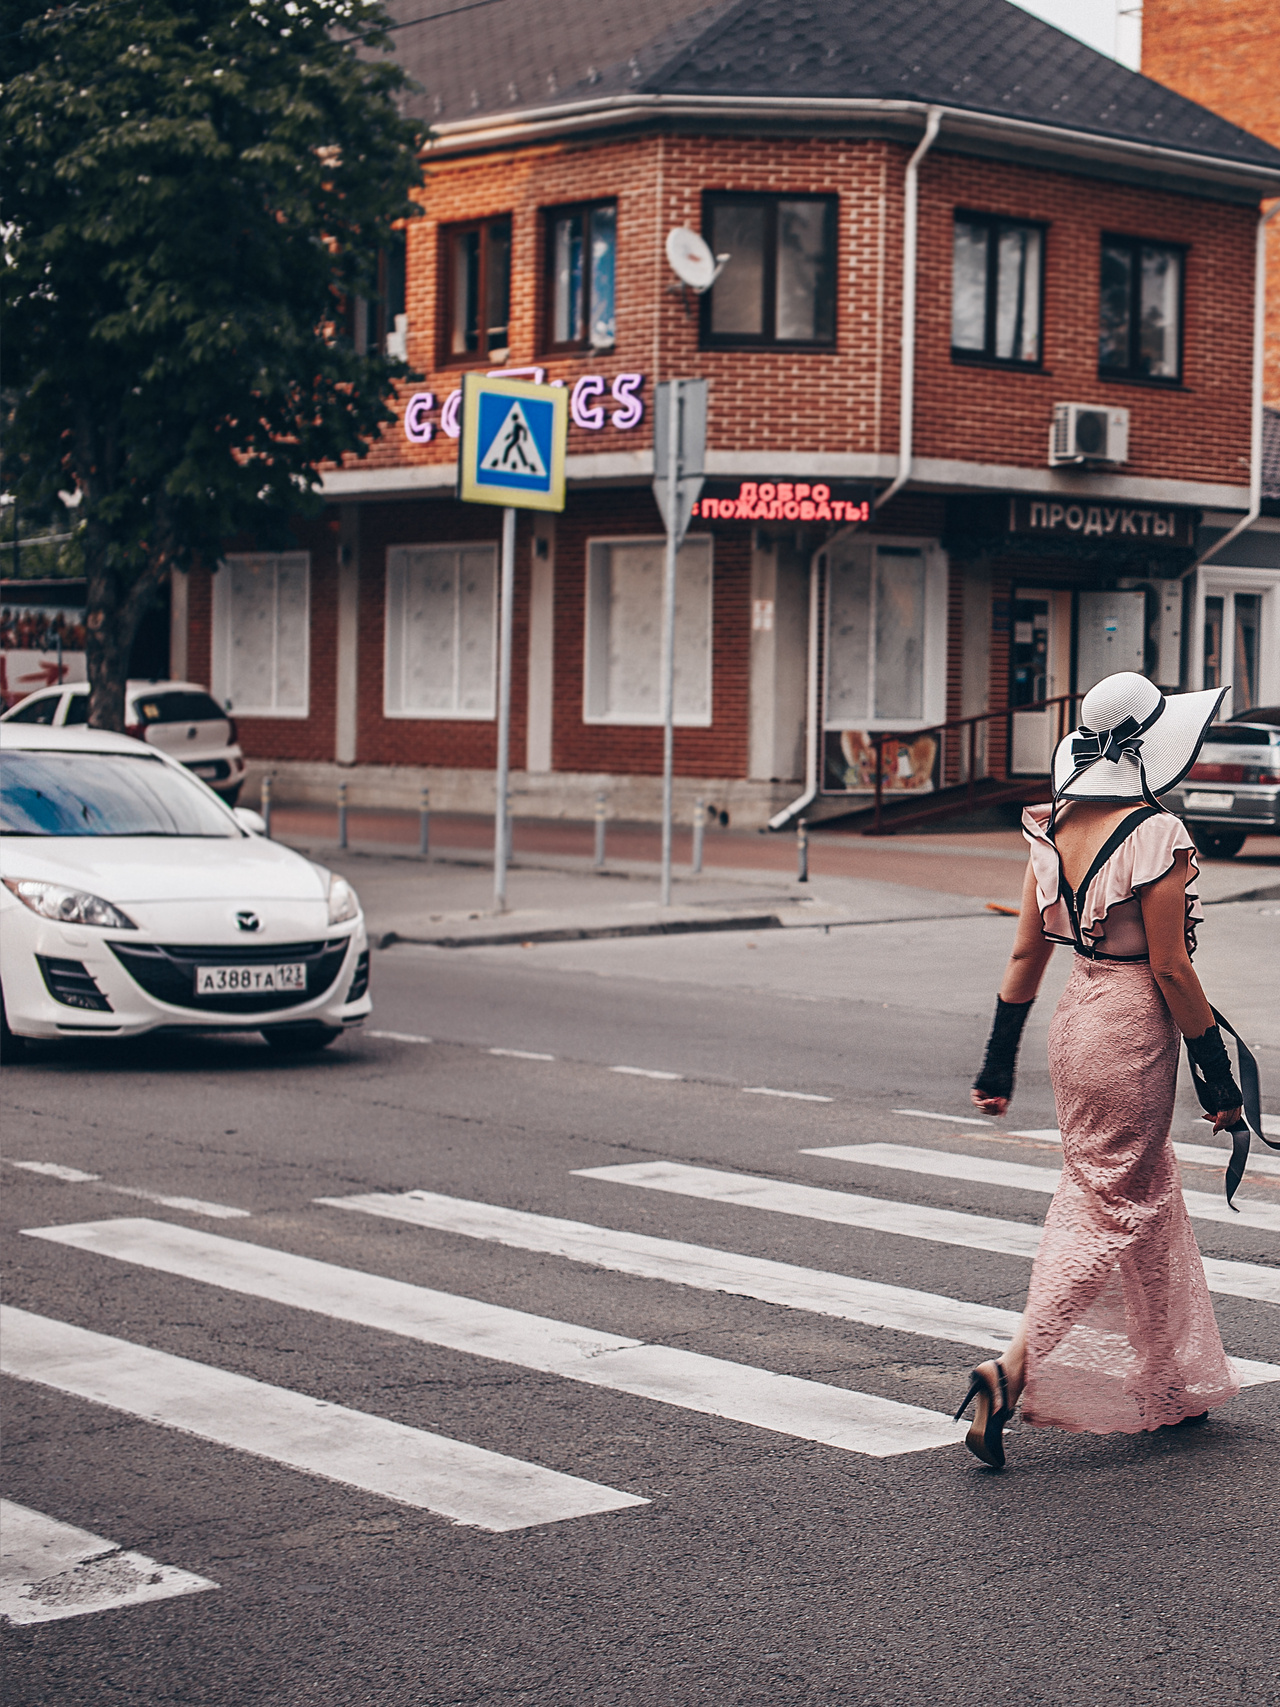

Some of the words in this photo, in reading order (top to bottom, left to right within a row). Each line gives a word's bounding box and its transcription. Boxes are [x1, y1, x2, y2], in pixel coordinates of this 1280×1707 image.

[739, 482, 831, 502] ДОБРО
[701, 498, 869, 521] ПОЖАЛОВАТЬ!
[1029, 502, 1176, 536] ПРОДУКТЫ
